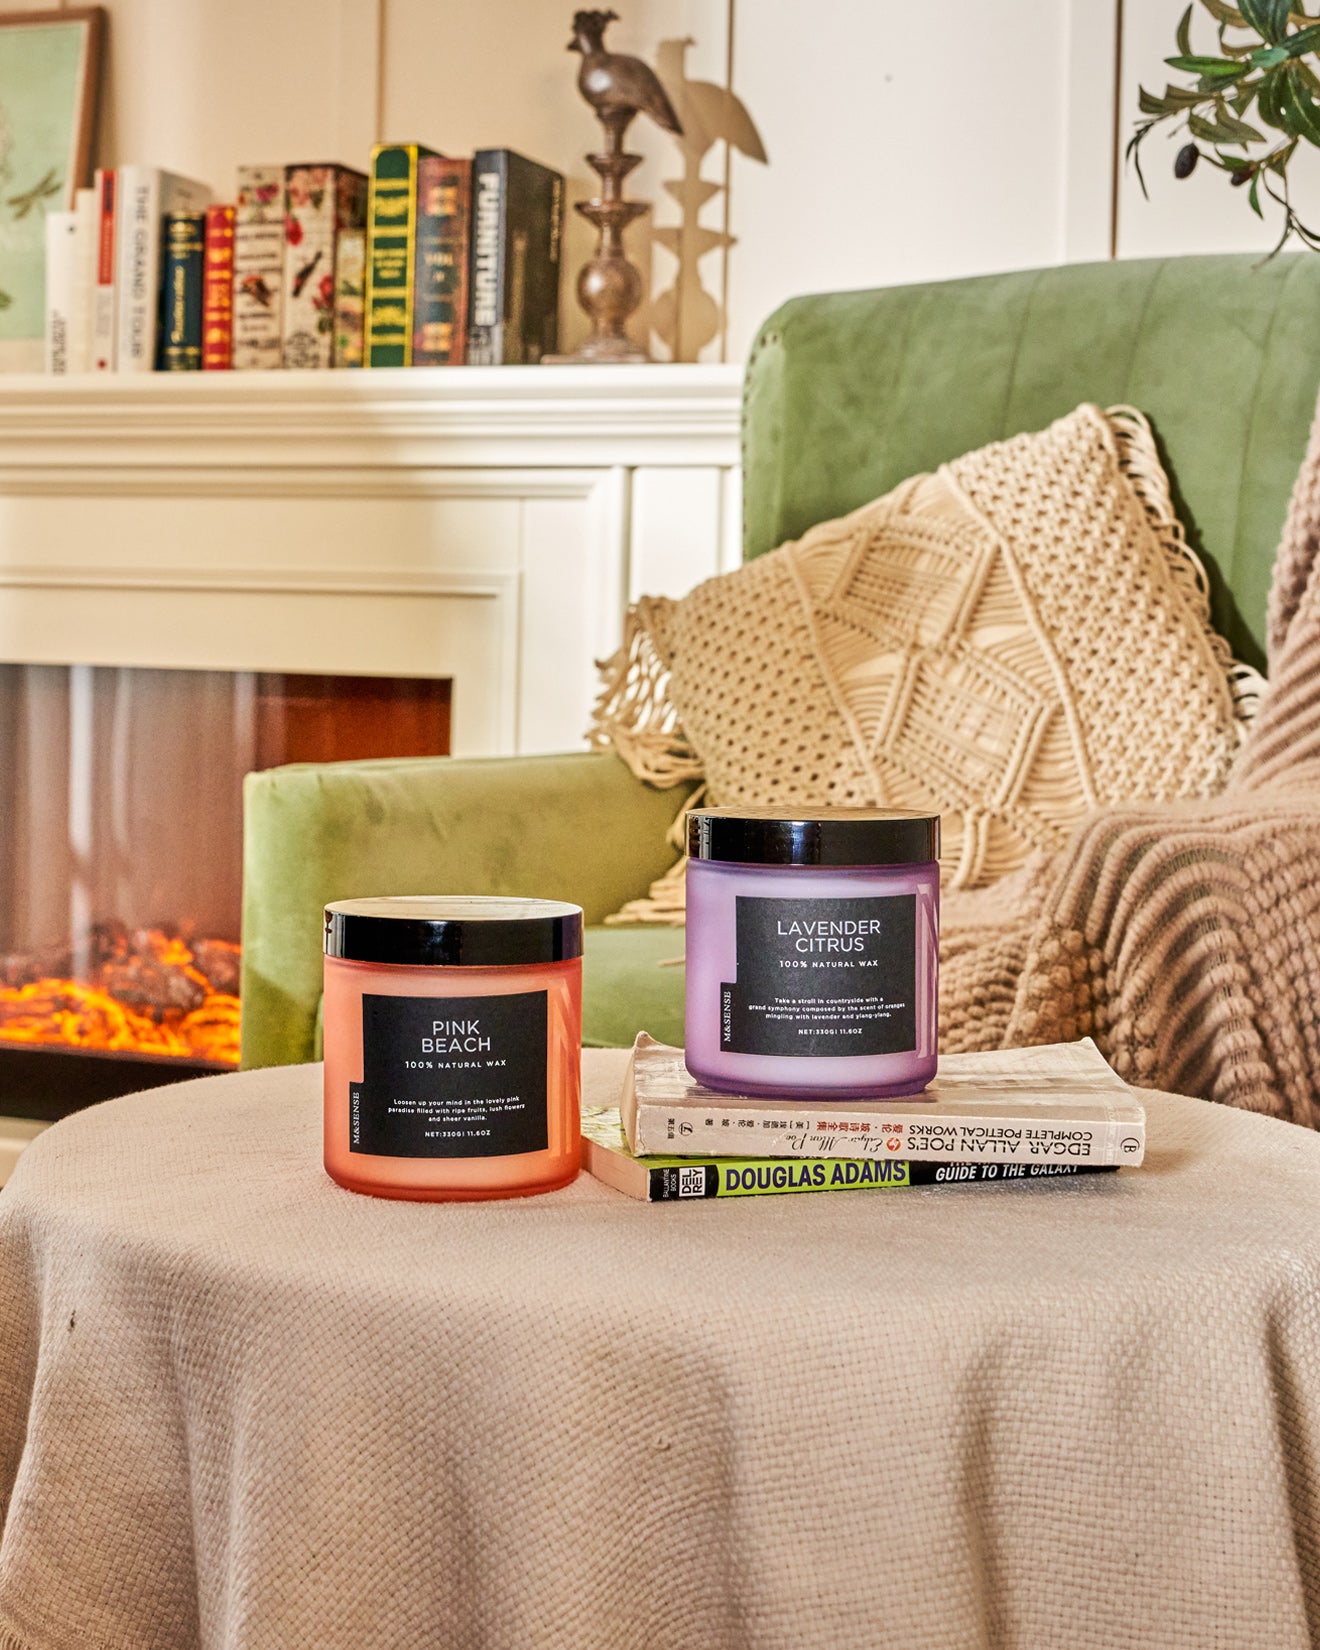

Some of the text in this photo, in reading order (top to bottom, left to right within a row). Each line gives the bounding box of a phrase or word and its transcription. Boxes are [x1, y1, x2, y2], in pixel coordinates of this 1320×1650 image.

[474, 172, 500, 327] FURNITURE
[777, 919, 881, 936] LAVENDER
[795, 937, 864, 953] CITRUS
[779, 959, 879, 968] 100% NATURAL WAX
[748, 1004, 766, 1012] grand
[767, 1005, 800, 1013] symphony
[826, 997, 864, 1005] countryside
[723, 991, 732, 1042] M&SENSE
[432, 1020, 480, 1036] PINK
[421, 1037, 491, 1053] BEACH
[405, 1059, 507, 1069] 100% NATURAL WAX
[445, 1098, 463, 1106] mind
[485, 1097, 505, 1105] lovely
[506, 1095, 520, 1103] pink
[387, 1106, 415, 1114] paradise
[452, 1107, 466, 1115] ripe
[463, 1114, 488, 1122] vanilla.
[909, 1125, 1093, 1141] COMPLETE POETICAL WORKS
[907, 1136, 1091, 1156] EDGAR ALLAN POE'S
[726, 1160, 906, 1191] DOUGLAS ADAMS
[935, 1165, 978, 1181] GUIDE
[981, 1164, 998, 1179] TO
[1002, 1163, 1026, 1178] THE
[662, 1168, 670, 1198] BALLANTINE
[681, 1169, 692, 1194] DEL
[692, 1168, 703, 1194] REY
